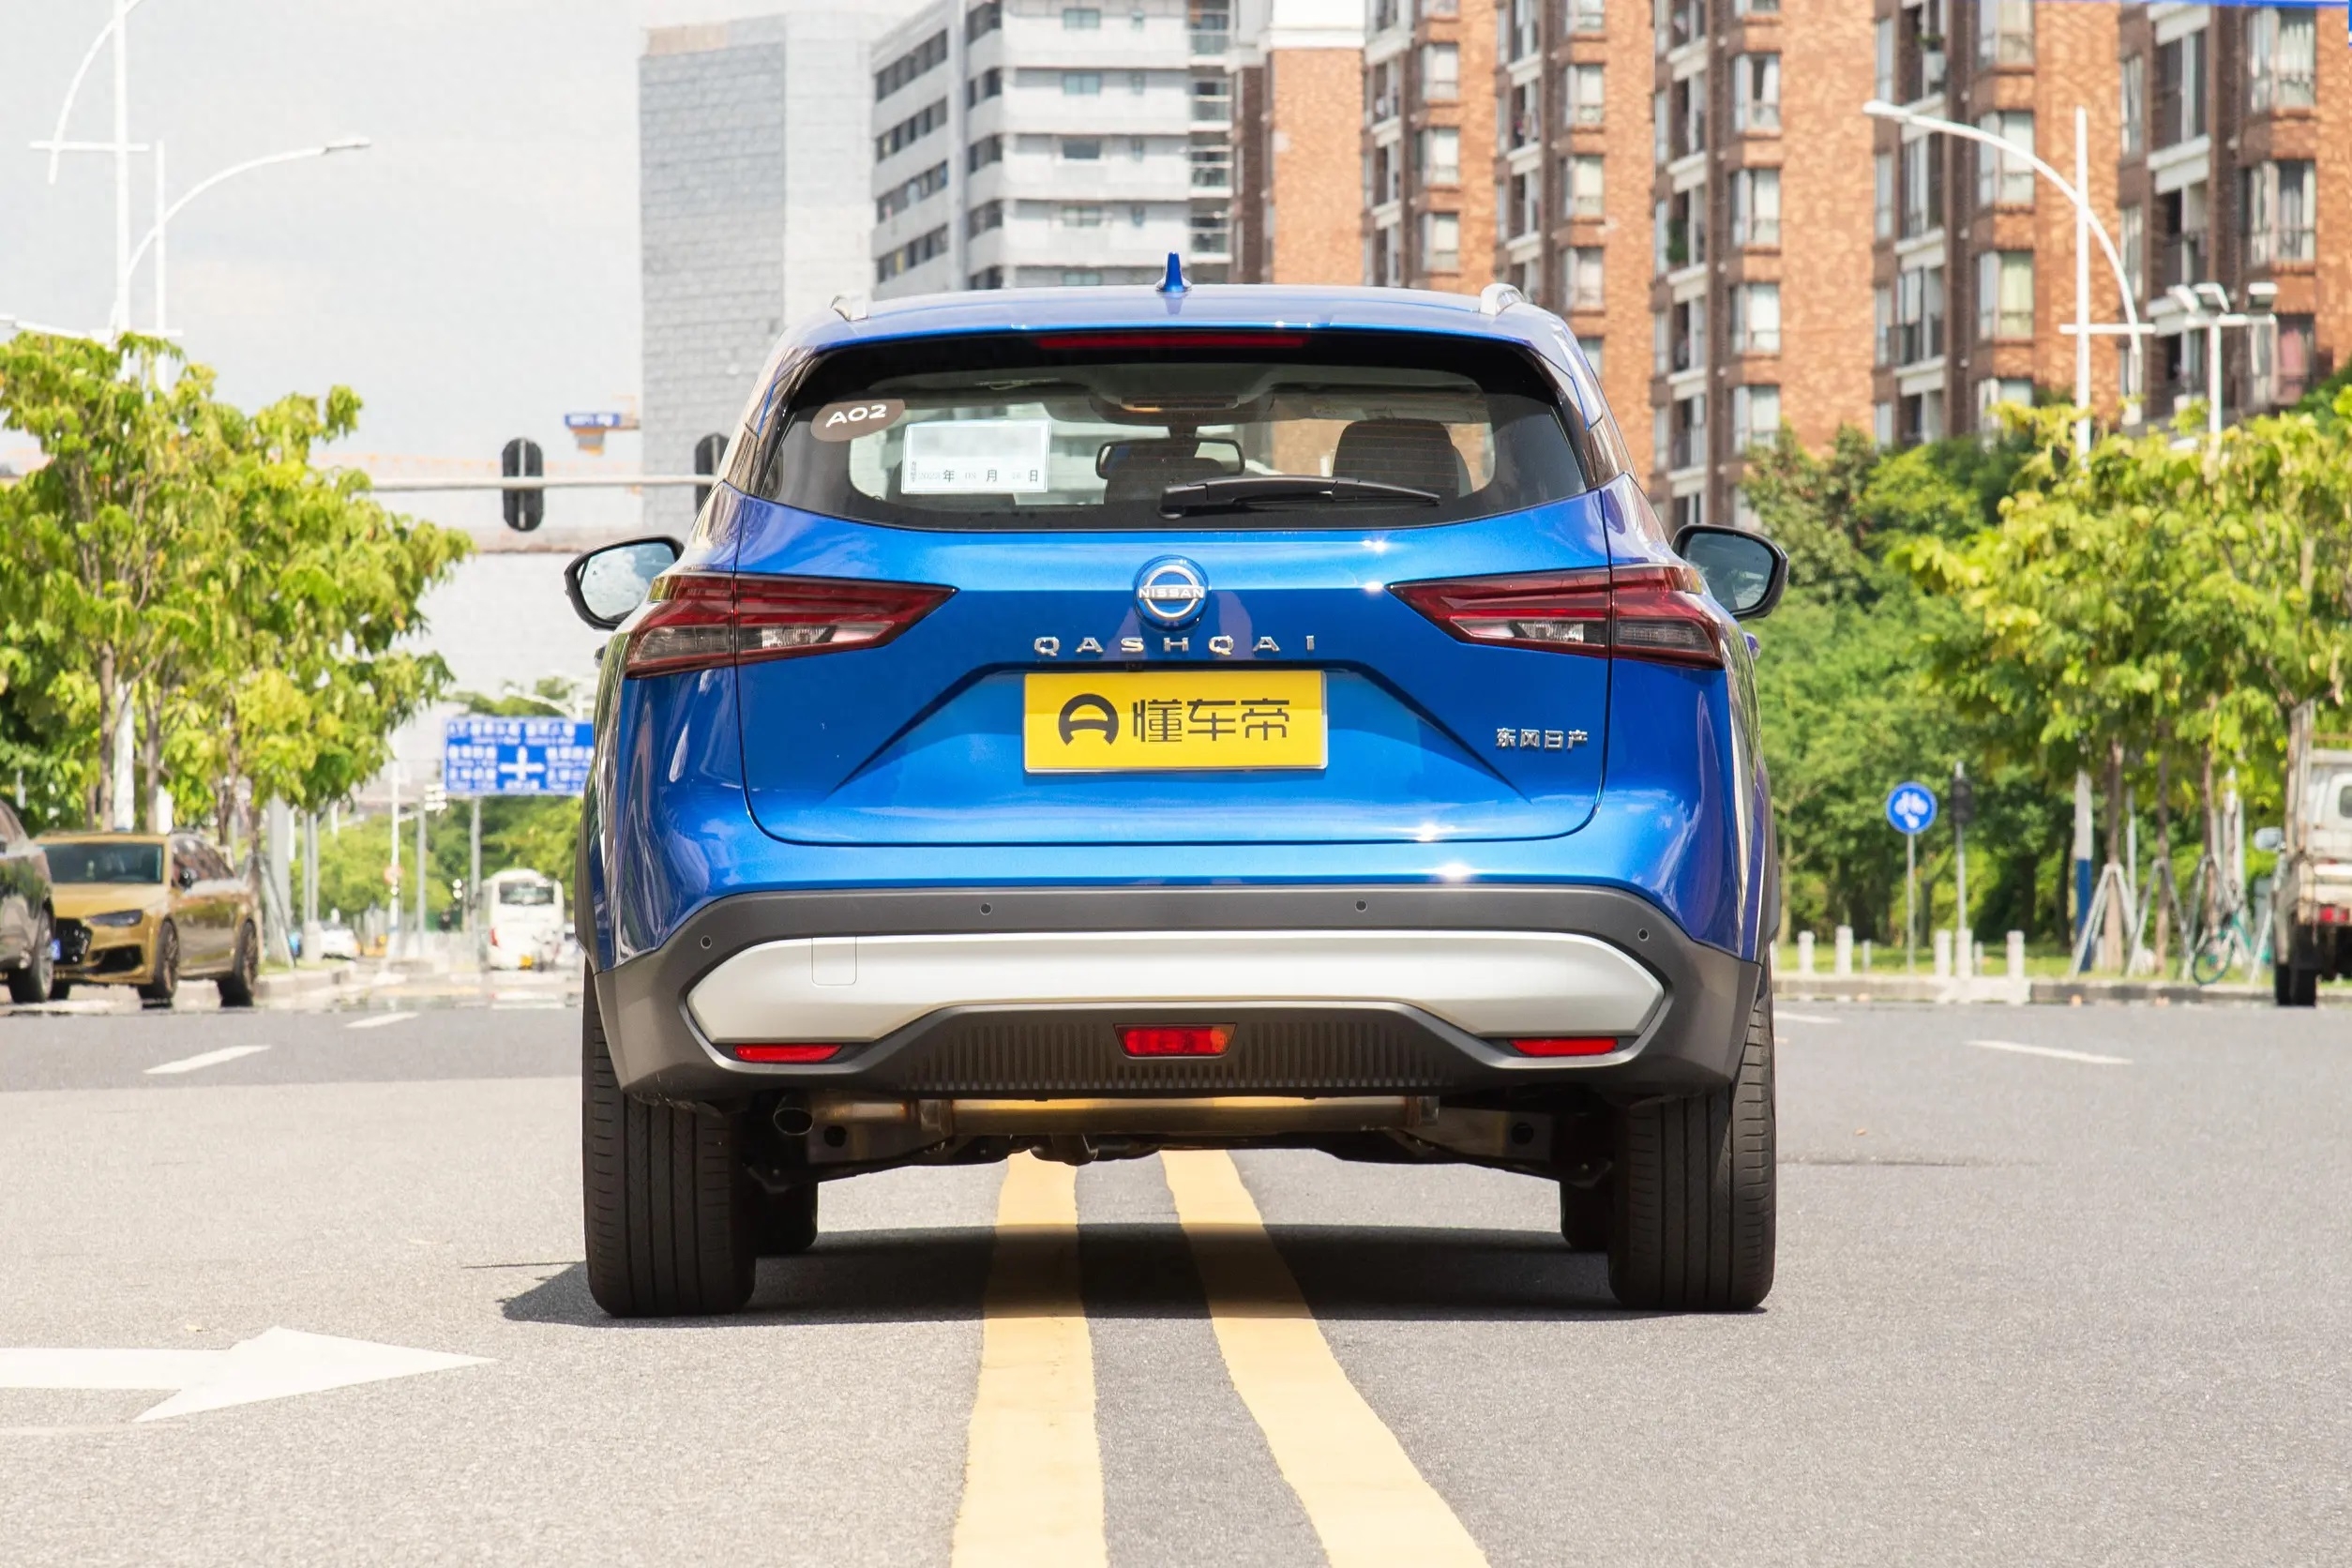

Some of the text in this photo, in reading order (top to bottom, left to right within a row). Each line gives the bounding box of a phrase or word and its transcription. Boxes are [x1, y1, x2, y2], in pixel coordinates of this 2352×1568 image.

[825, 403, 887, 429] A02
[942, 469, 956, 483] 年
[986, 469, 998, 482] 月
[1029, 469, 1039, 482] 日
[1138, 587, 1205, 600] NISSAN
[1033, 634, 1315, 656] QASHQAI
[1132, 697, 1290, 744] 懂车帝
[1495, 727, 1589, 750] 东风日产
